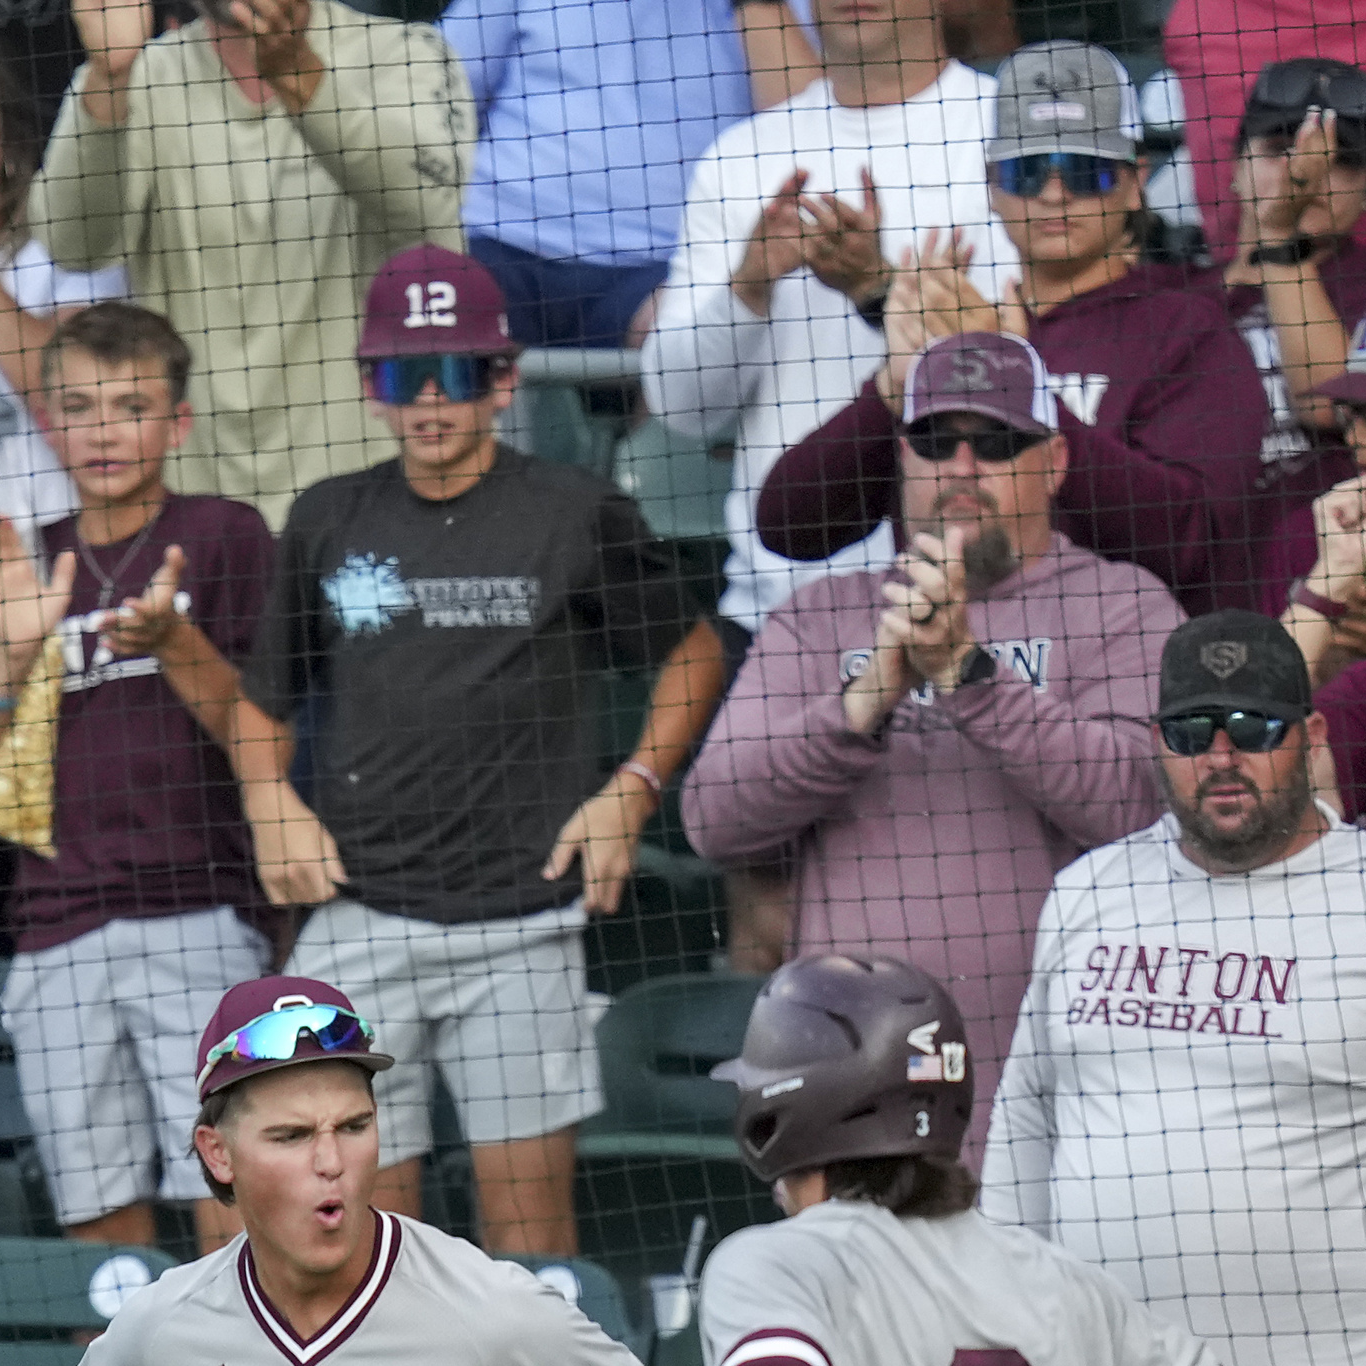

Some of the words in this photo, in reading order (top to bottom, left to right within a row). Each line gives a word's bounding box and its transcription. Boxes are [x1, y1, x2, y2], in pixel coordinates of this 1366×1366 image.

[403, 281, 457, 328] 12
[1080, 944, 1297, 1005] SINTON
[1067, 997, 1283, 1038] BASEBALL
[914, 1110, 931, 1137] 3
